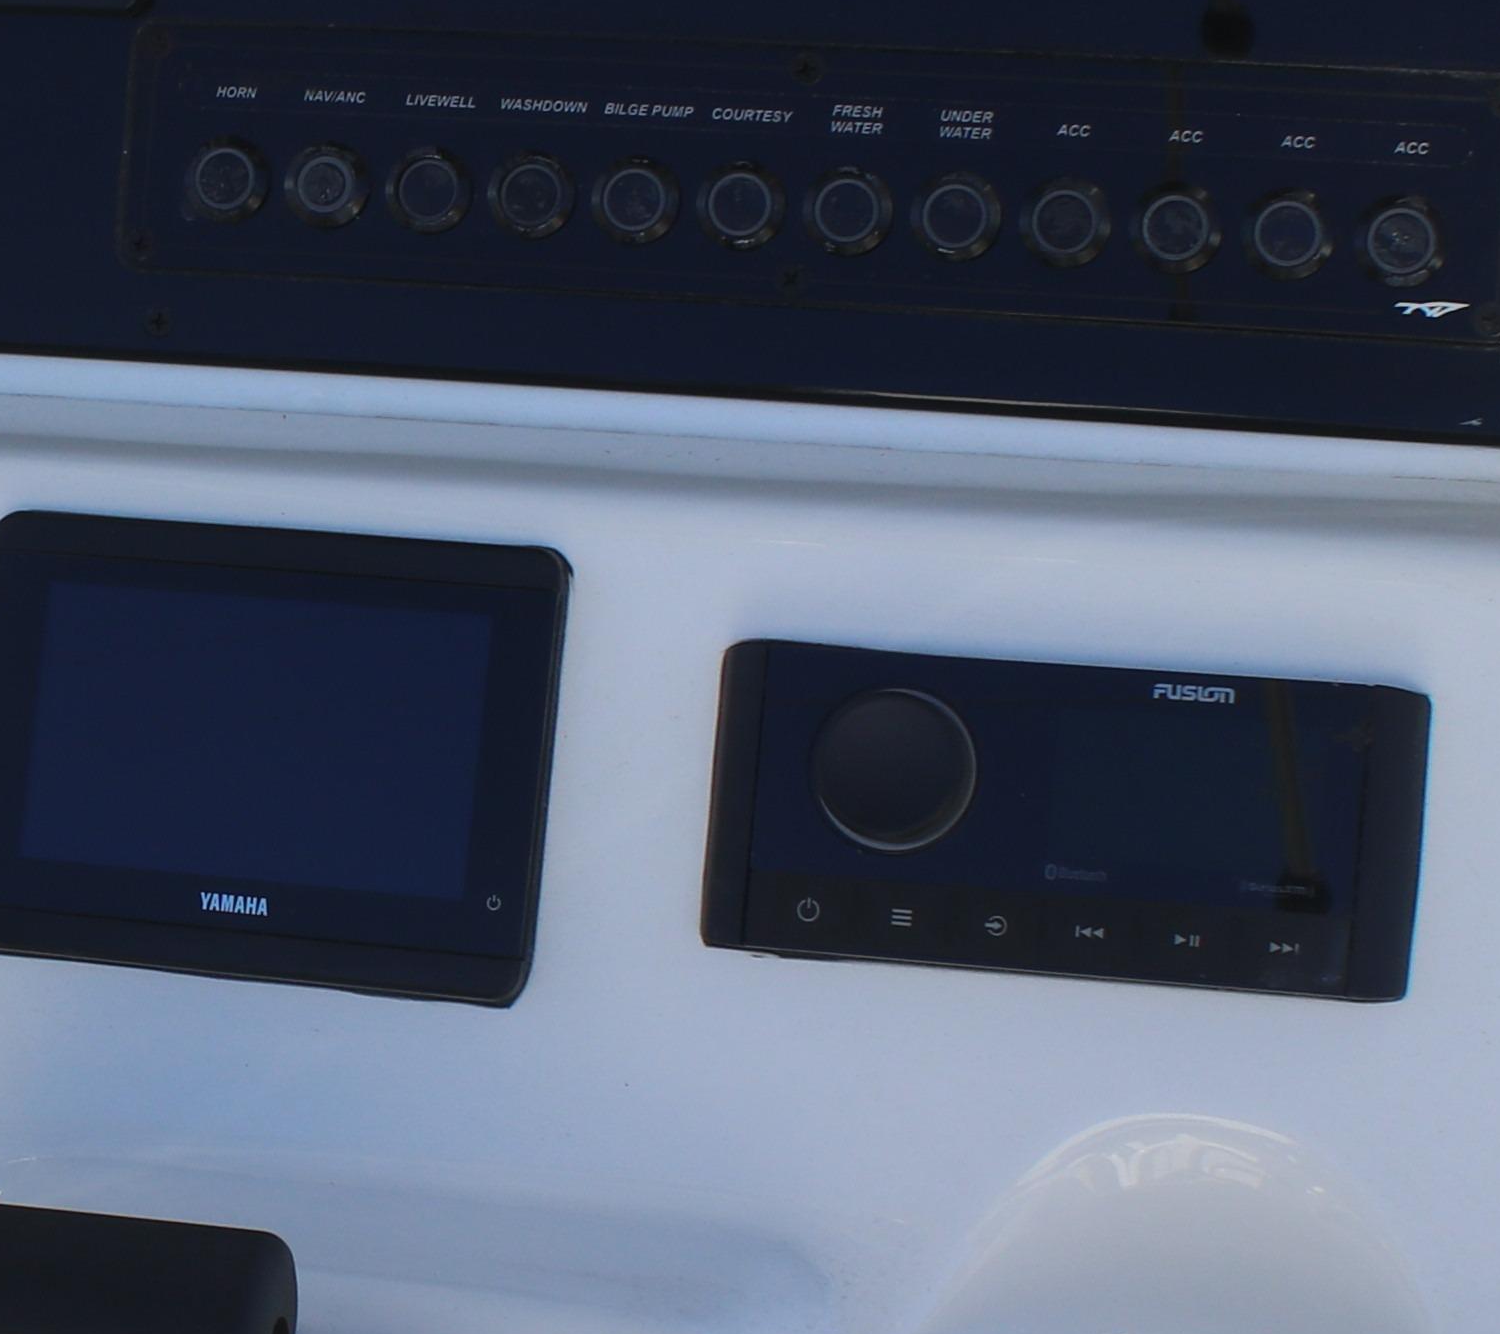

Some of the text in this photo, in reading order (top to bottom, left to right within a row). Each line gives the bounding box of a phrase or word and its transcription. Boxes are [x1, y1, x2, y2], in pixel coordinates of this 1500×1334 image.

[216, 85, 257, 99] HORN
[304, 88, 366, 104] NAV/ANC
[405, 93, 476, 109] LIVEWELL
[500, 98, 588, 114] WASHDOWN
[604, 102, 694, 119] BILGE PUMP
[711, 107, 793, 123] COURTESY
[832, 104, 883, 119] FRESH
[940, 109, 994, 124] UNDER
[831, 120, 883, 135] WATER
[939, 125, 993, 140] WATER
[1057, 124, 1091, 138] ACC
[1169, 130, 1204, 144] ACC
[1281, 135, 1316, 150] ACC
[1394, 141, 1429, 156] ACC
[1152, 683, 1236, 704] FUSION
[200, 891, 268, 917] YAMAHA
